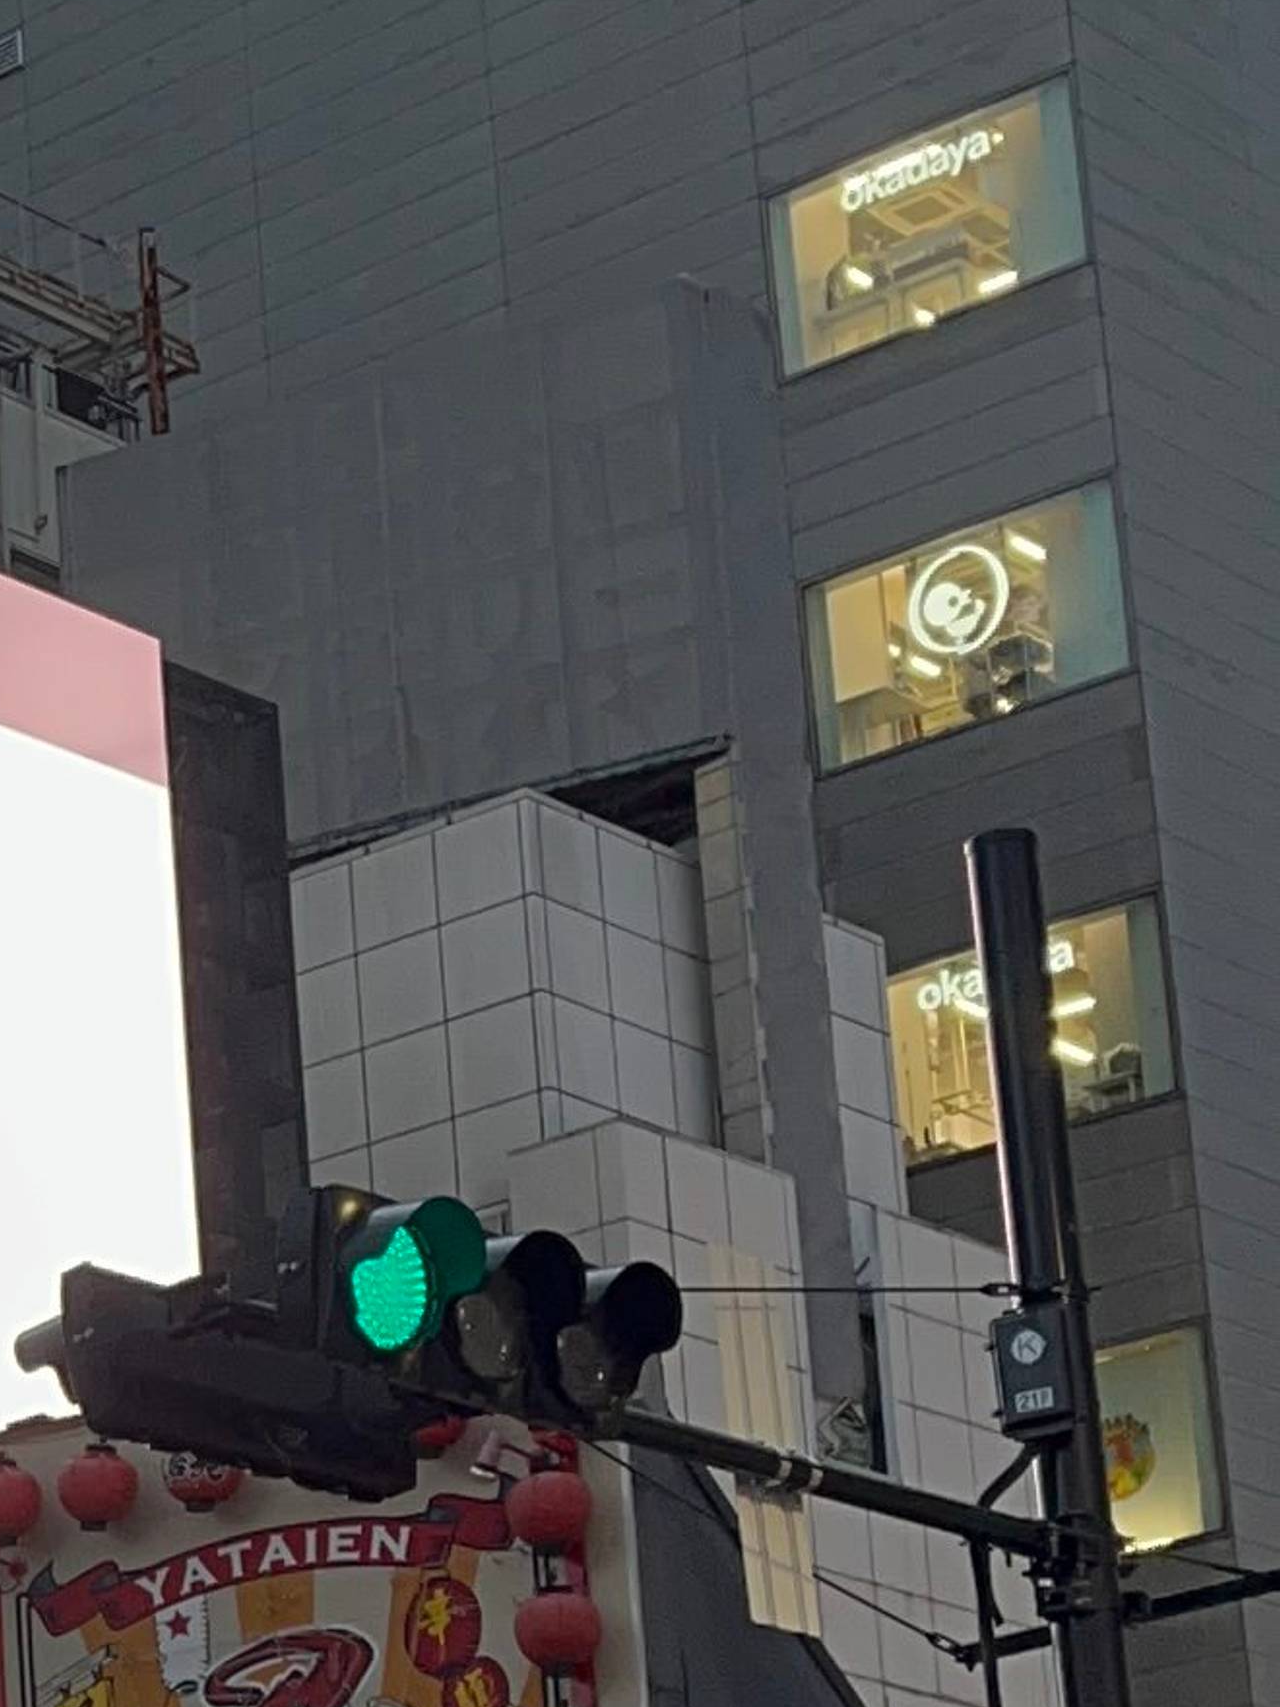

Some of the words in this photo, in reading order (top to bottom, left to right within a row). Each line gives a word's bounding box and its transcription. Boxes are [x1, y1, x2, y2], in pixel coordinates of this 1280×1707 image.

[841, 129, 991, 212] okadaya
[917, 936, 1075, 1011] okaa
[139, 1523, 413, 1609] YATAIEN
